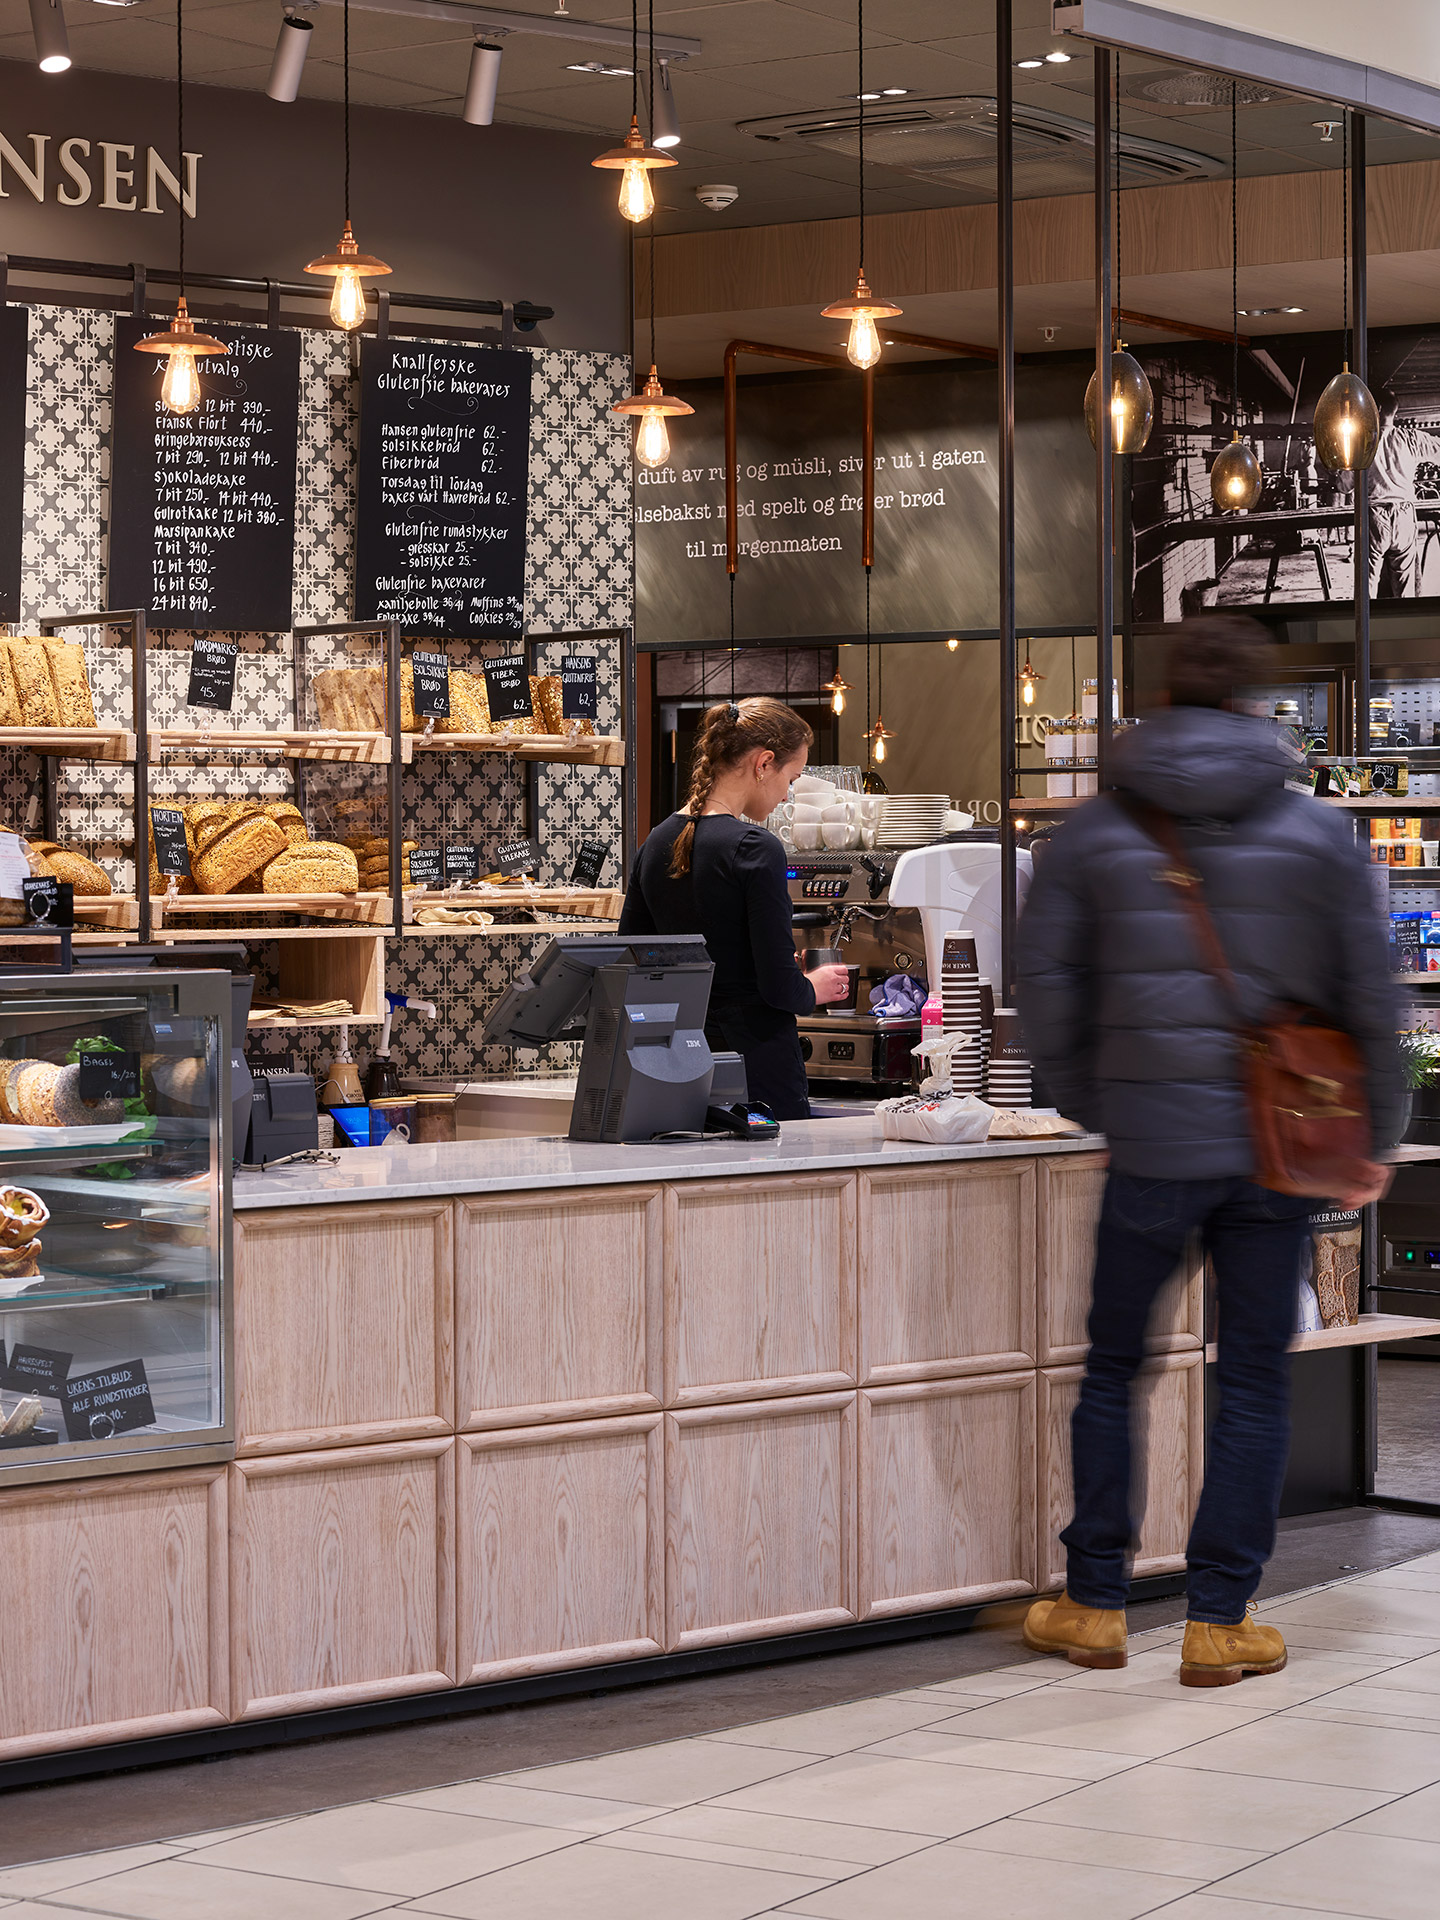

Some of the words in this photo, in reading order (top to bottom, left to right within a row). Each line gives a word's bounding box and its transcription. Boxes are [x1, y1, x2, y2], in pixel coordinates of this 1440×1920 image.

[377, 373, 445, 399] Glutenfrie
[205, 399, 216, 412] 12
[219, 398, 237, 413] bit
[155, 416, 193, 430] Fransk
[381, 423, 418, 437] Hansen
[420, 424, 476, 443] glutenfrie
[155, 451, 163, 464] 7
[165, 449, 181, 464] bit
[219, 451, 230, 466] 12
[233, 451, 248, 465] bit
[638, 467, 676, 485] duft
[682, 469, 704, 483] av
[747, 463, 768, 481] og
[773, 457, 832, 477] müsli,
[838, 456, 885, 473] sivr
[891, 452, 913, 468] ut
[919, 451, 926, 467] i
[932, 449, 986, 471] gaten
[381, 476, 427, 489] Torsdag
[430, 474, 443, 489] til
[155, 488, 163, 501] 7
[165, 487, 182, 501] bit
[219, 491, 231, 506] 14
[232, 490, 248, 506] bit
[381, 491, 415, 508] bakes
[762, 497, 807, 519] spelt
[813, 499, 835, 516] og
[899, 488, 946, 508] brød
[154, 506, 218, 520] Gulrotkake
[223, 509, 235, 523] 12
[237, 508, 253, 523] bit
[154, 523, 235, 543] Marsipankake
[385, 520, 440, 544] Glutenfrie
[443, 524, 509, 544] rundstykker
[154, 541, 163, 555] 7
[165, 540, 181, 554] bit
[408, 542, 450, 556] gresskar
[686, 541, 707, 558] til
[712, 536, 842, 558] mrgenmaten
[152, 559, 166, 574] 12
[168, 558, 185, 573] bit
[409, 555, 455, 571] solsikke
[153, 577, 166, 592] 16
[169, 576, 185, 591] bit
[375, 574, 427, 595] Glutenfrie
[431, 576, 487, 593] bakevarer
[151, 596, 169, 611] 24
[170, 594, 186, 609] bit
[470, 597, 504, 612] Muffins
[469, 612, 504, 627] Cookies
[421, 679, 441, 691] BRØD
[153, 809, 183, 823] HORTEN
[686, 1039, 701, 1048] IBM
[253, 1066, 290, 1077] HANSEN
[253, 1093, 265, 1101] IBM
[1308, 1213, 1330, 1223] BAKER
[1331, 1210, 1360, 1221] HANSEN
[66, 1378, 96, 1395] UKENS
[97, 1370, 133, 1388] TILBUD:
[71, 1398, 91, 1414] ALLE
[93, 1383, 149, 1407] RUNDSTYKKER
